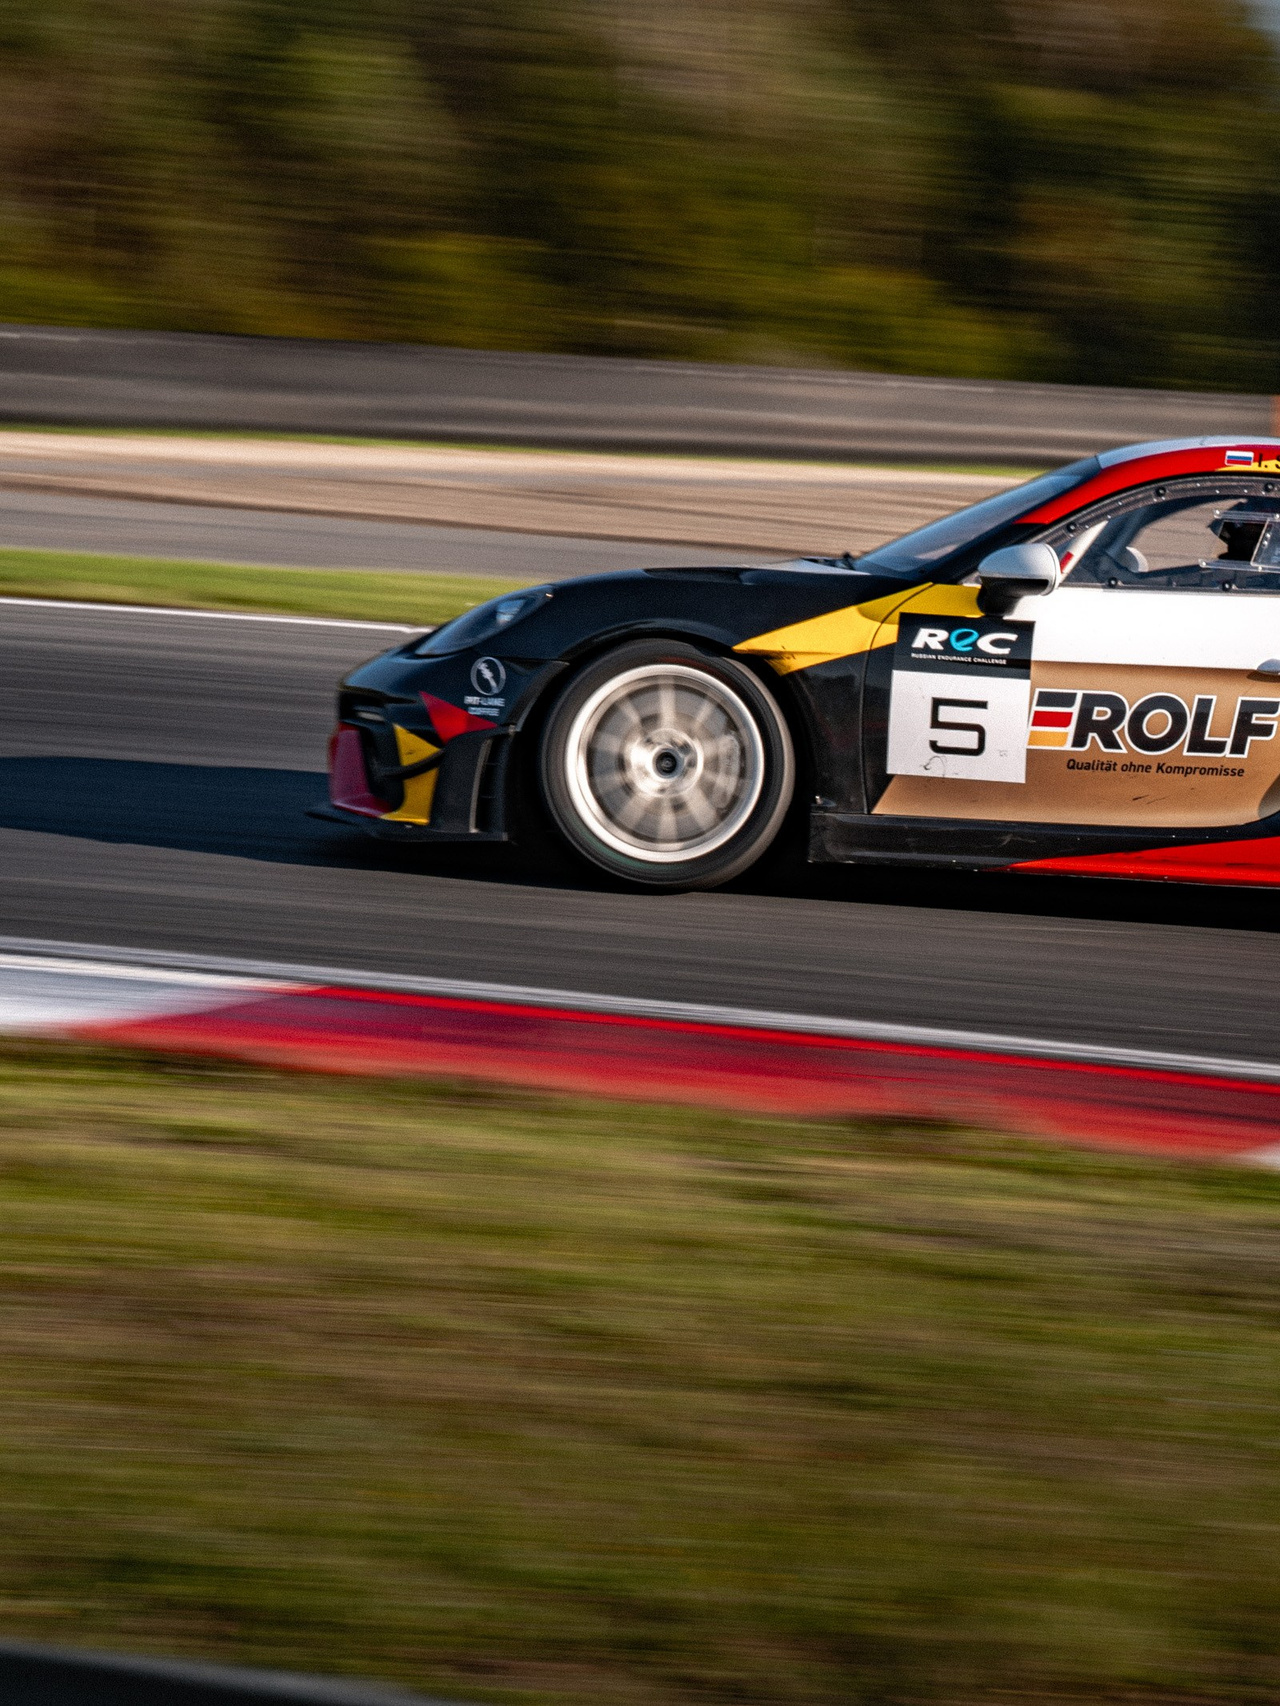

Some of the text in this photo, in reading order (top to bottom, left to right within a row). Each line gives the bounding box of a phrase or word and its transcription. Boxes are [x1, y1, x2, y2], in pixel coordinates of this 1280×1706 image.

[1257, 453, 1268, 469] I.
[911, 652, 1007, 665] RUSSIAN ENDURANCE CHALLENGE
[929, 697, 988, 756] 5
[1066, 758, 1245, 778] Qualität ohne Kompromisse
